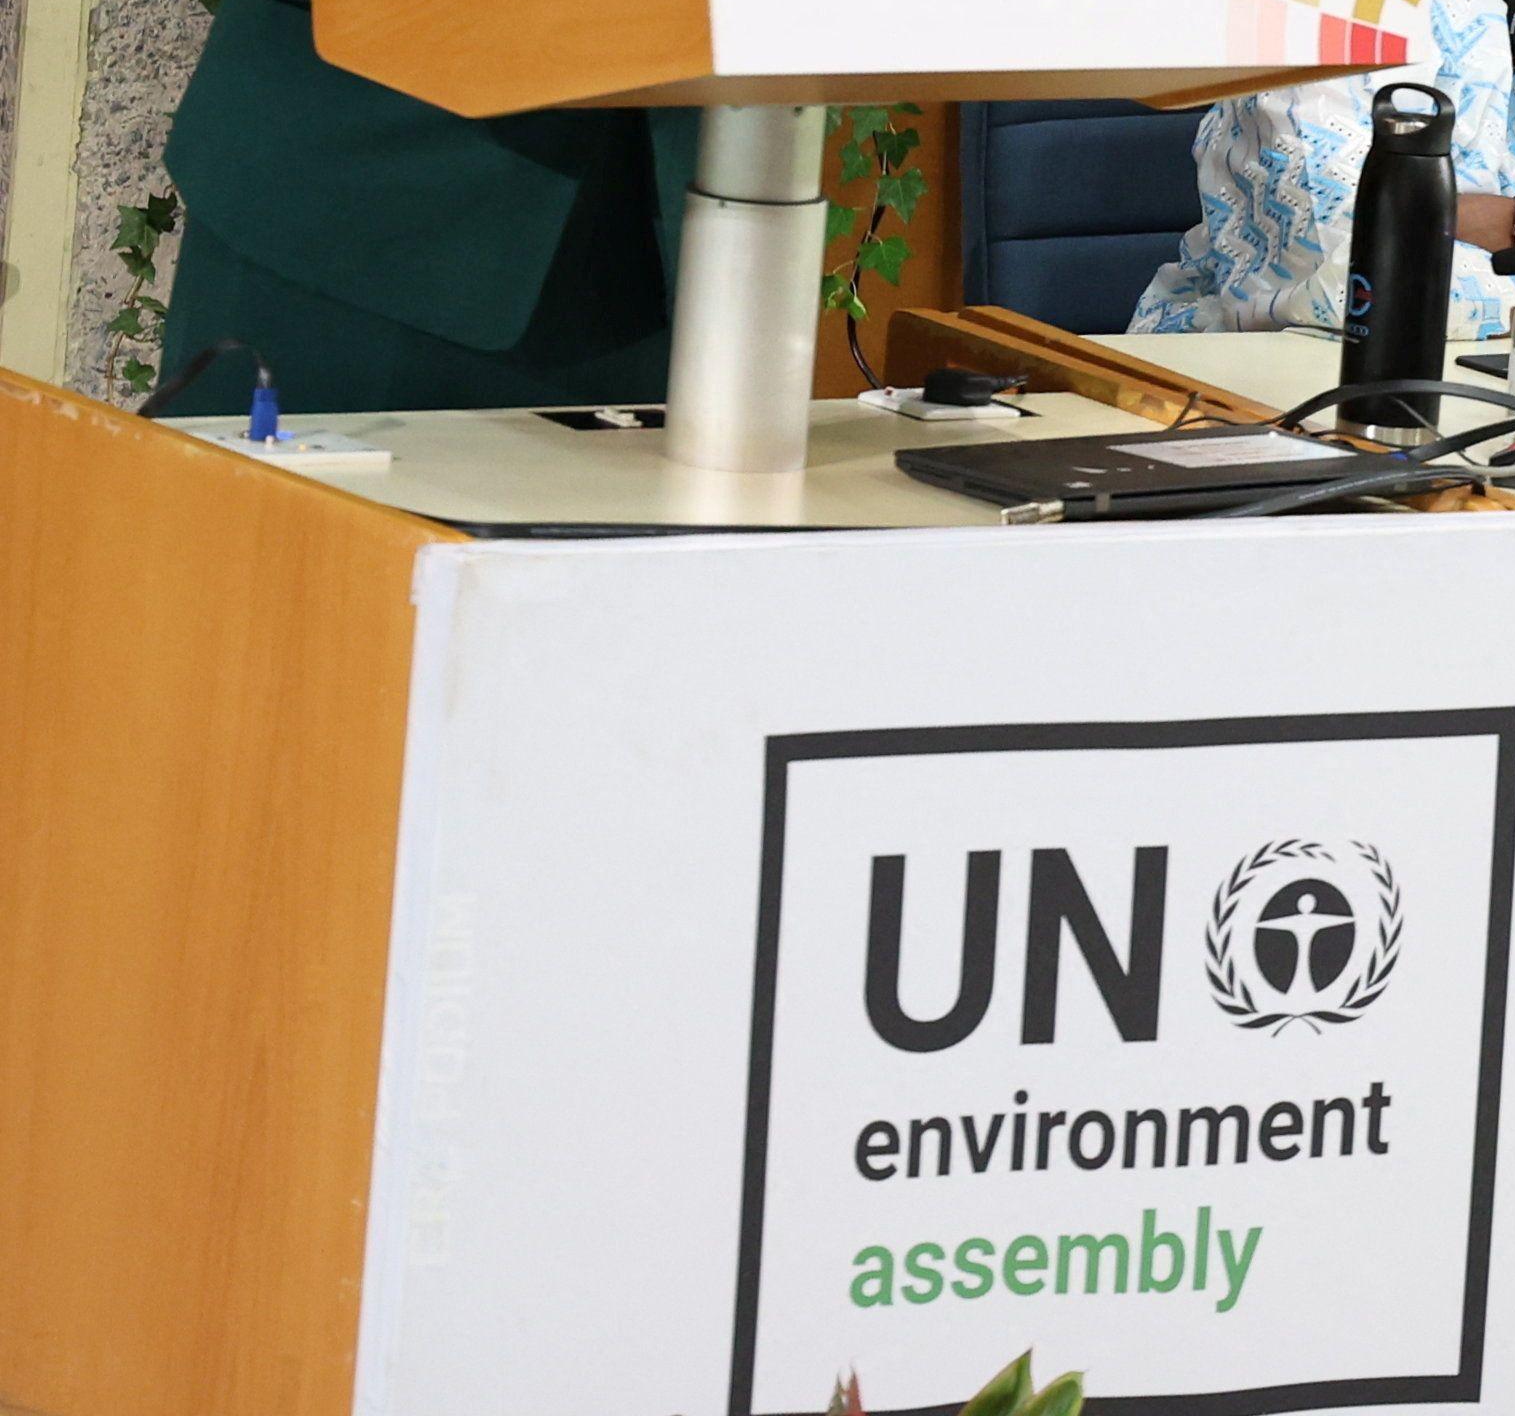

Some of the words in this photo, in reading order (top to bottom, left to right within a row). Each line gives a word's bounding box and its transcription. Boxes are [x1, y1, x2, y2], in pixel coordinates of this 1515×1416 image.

[864, 846, 1169, 1053] UN
[855, 1082, 1391, 1181] environment
[850, 1206, 1263, 1313] assembly
